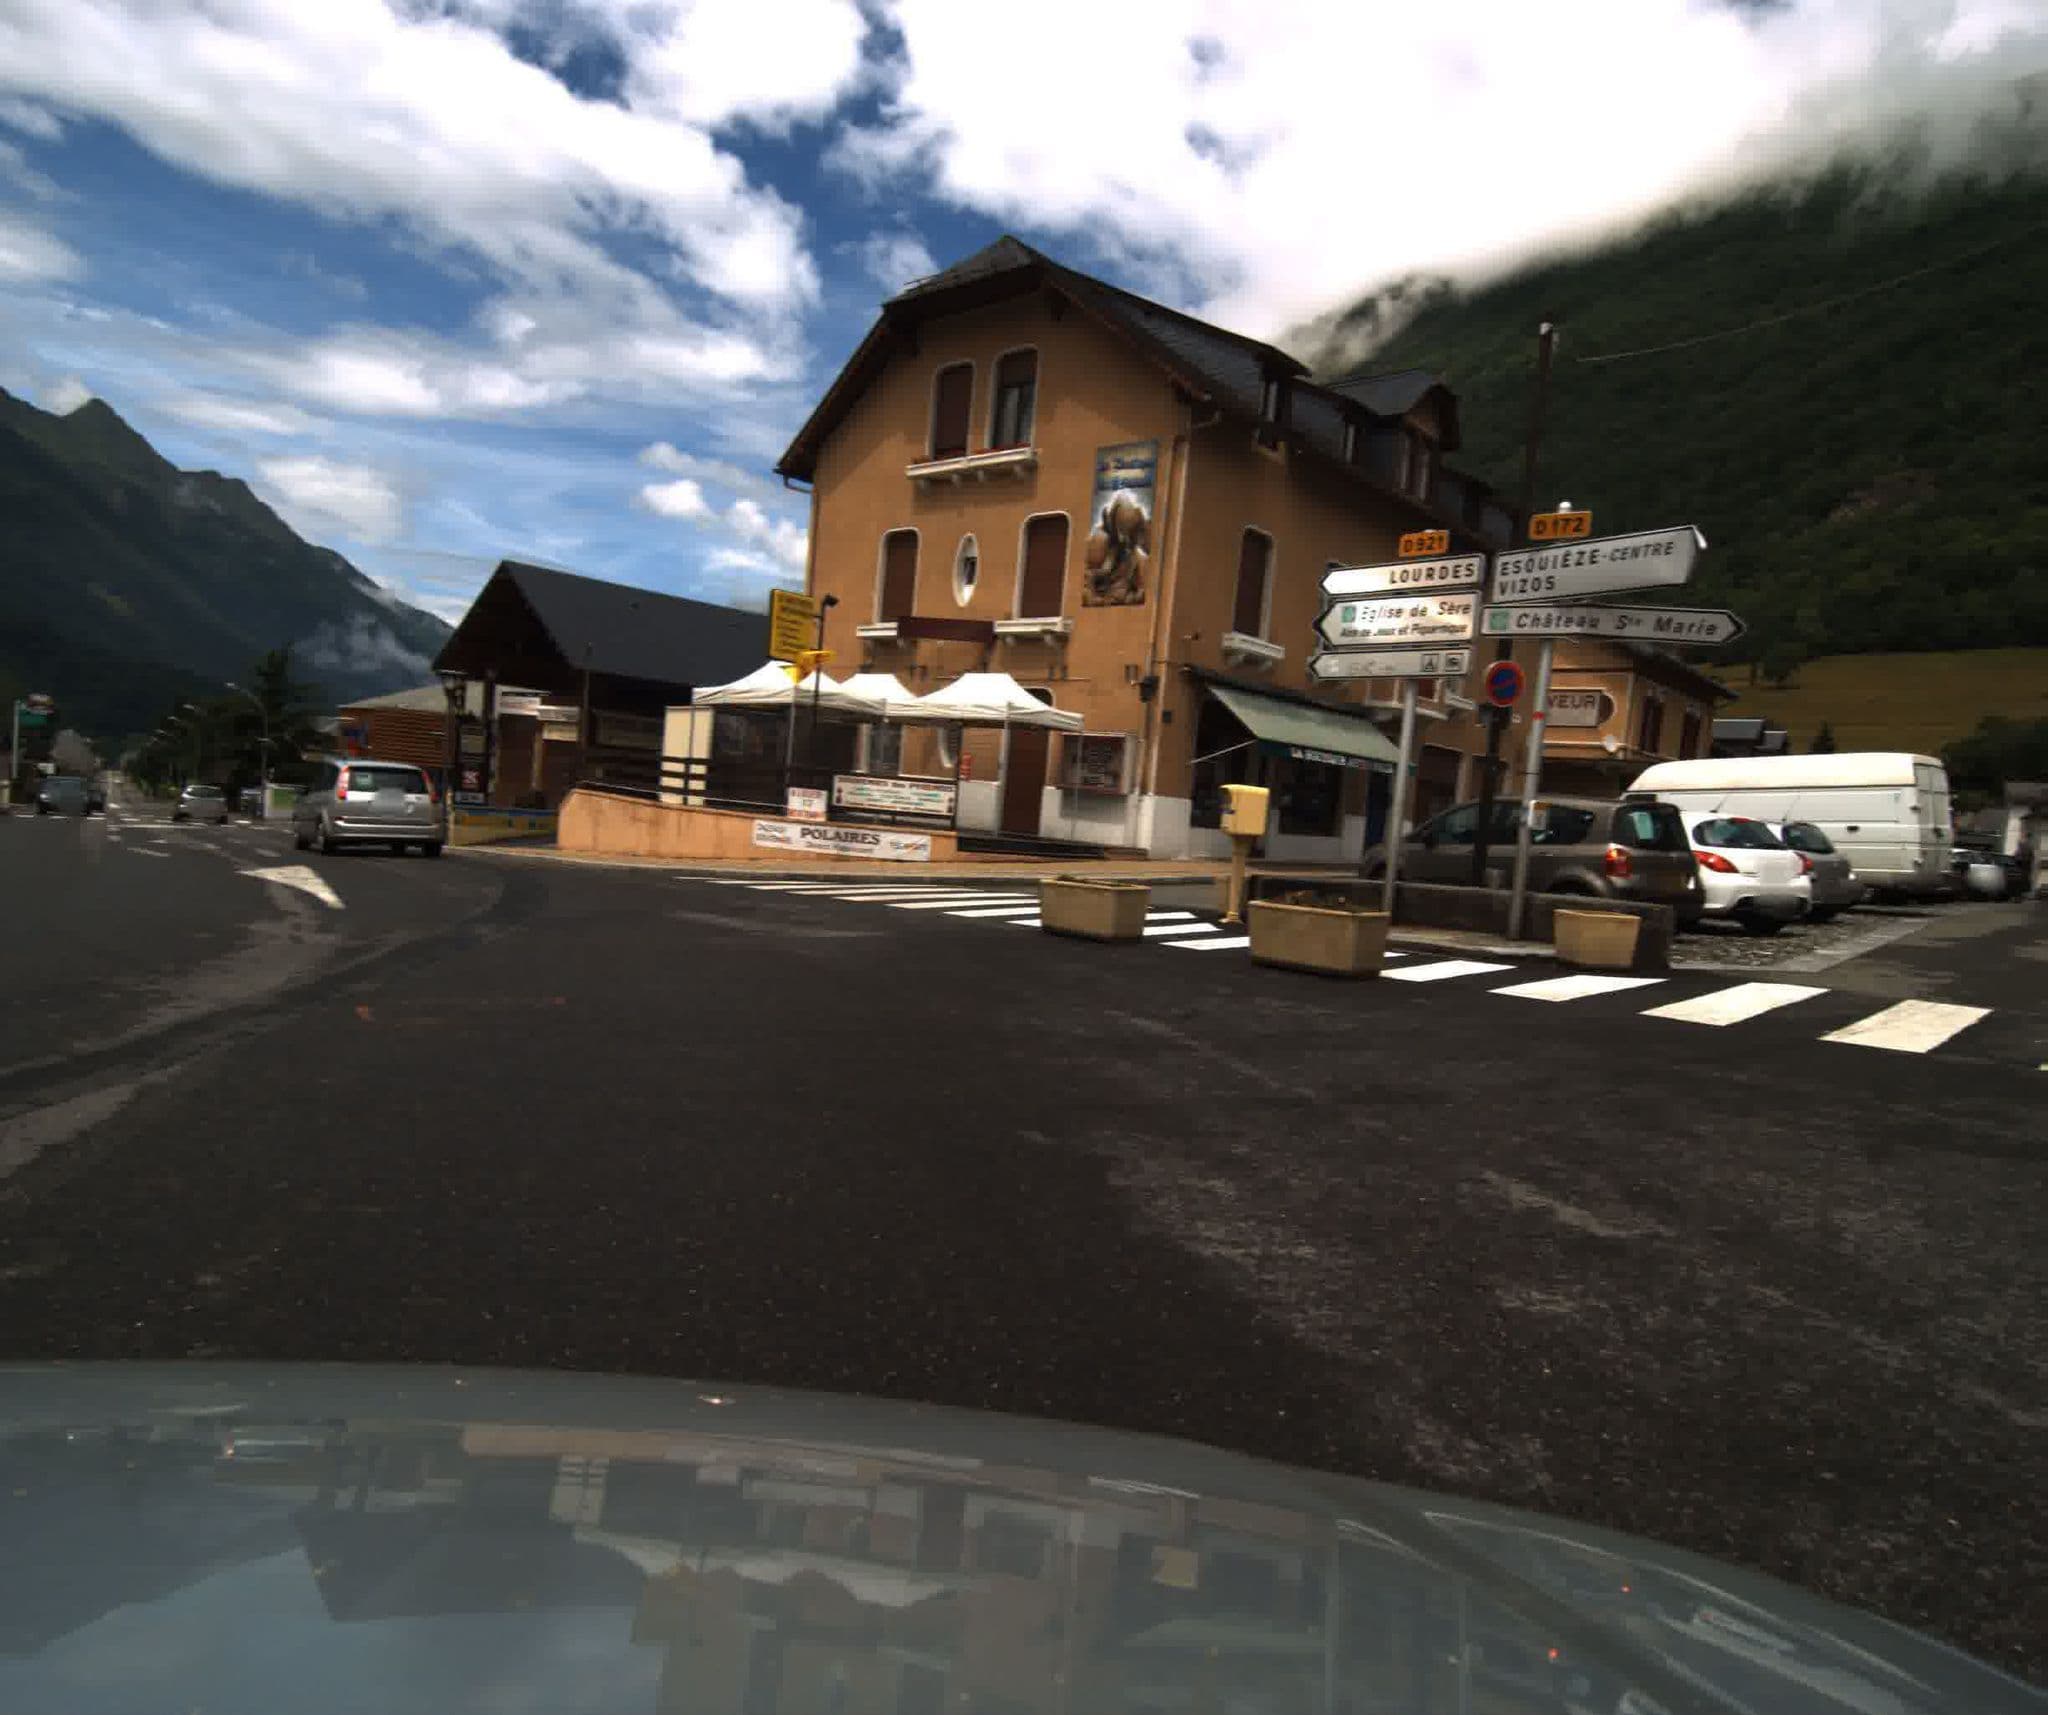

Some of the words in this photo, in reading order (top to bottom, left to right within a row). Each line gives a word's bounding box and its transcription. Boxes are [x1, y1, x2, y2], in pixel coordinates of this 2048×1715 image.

[1390, 562, 1475, 585] LOURDES
[1500, 575, 1556, 597] VIZOS
[1410, 603, 1428, 618] de
[1516, 612, 1600, 630] Château
[1652, 616, 1719, 637] Marie
[800, 827, 881, 846] POLAIRES
